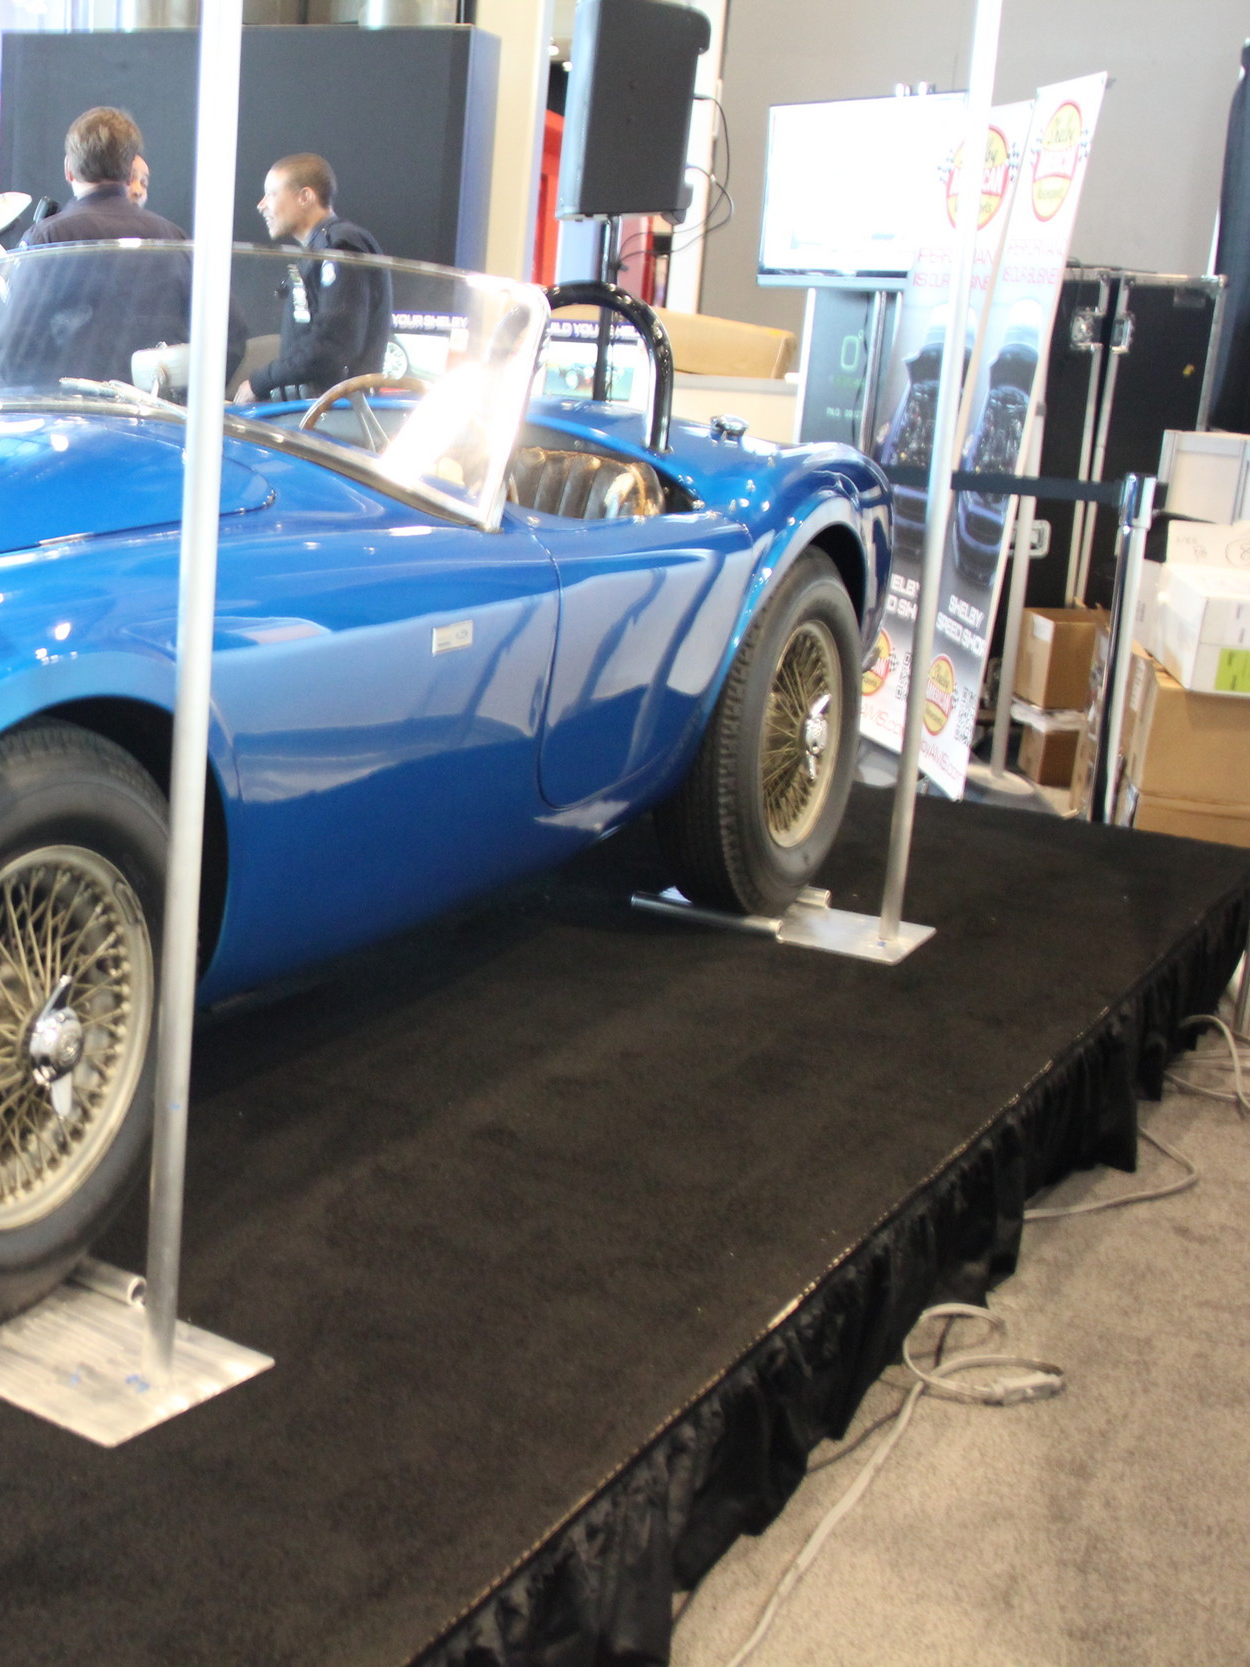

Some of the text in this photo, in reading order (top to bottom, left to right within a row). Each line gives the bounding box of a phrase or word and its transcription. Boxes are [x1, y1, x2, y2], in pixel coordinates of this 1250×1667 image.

[392, 314, 469, 329] YOUR SHELBY
[573, 322, 600, 339] YOU
[948, 593, 985, 631] SHELBY
[935, 611, 963, 643] SPEED
